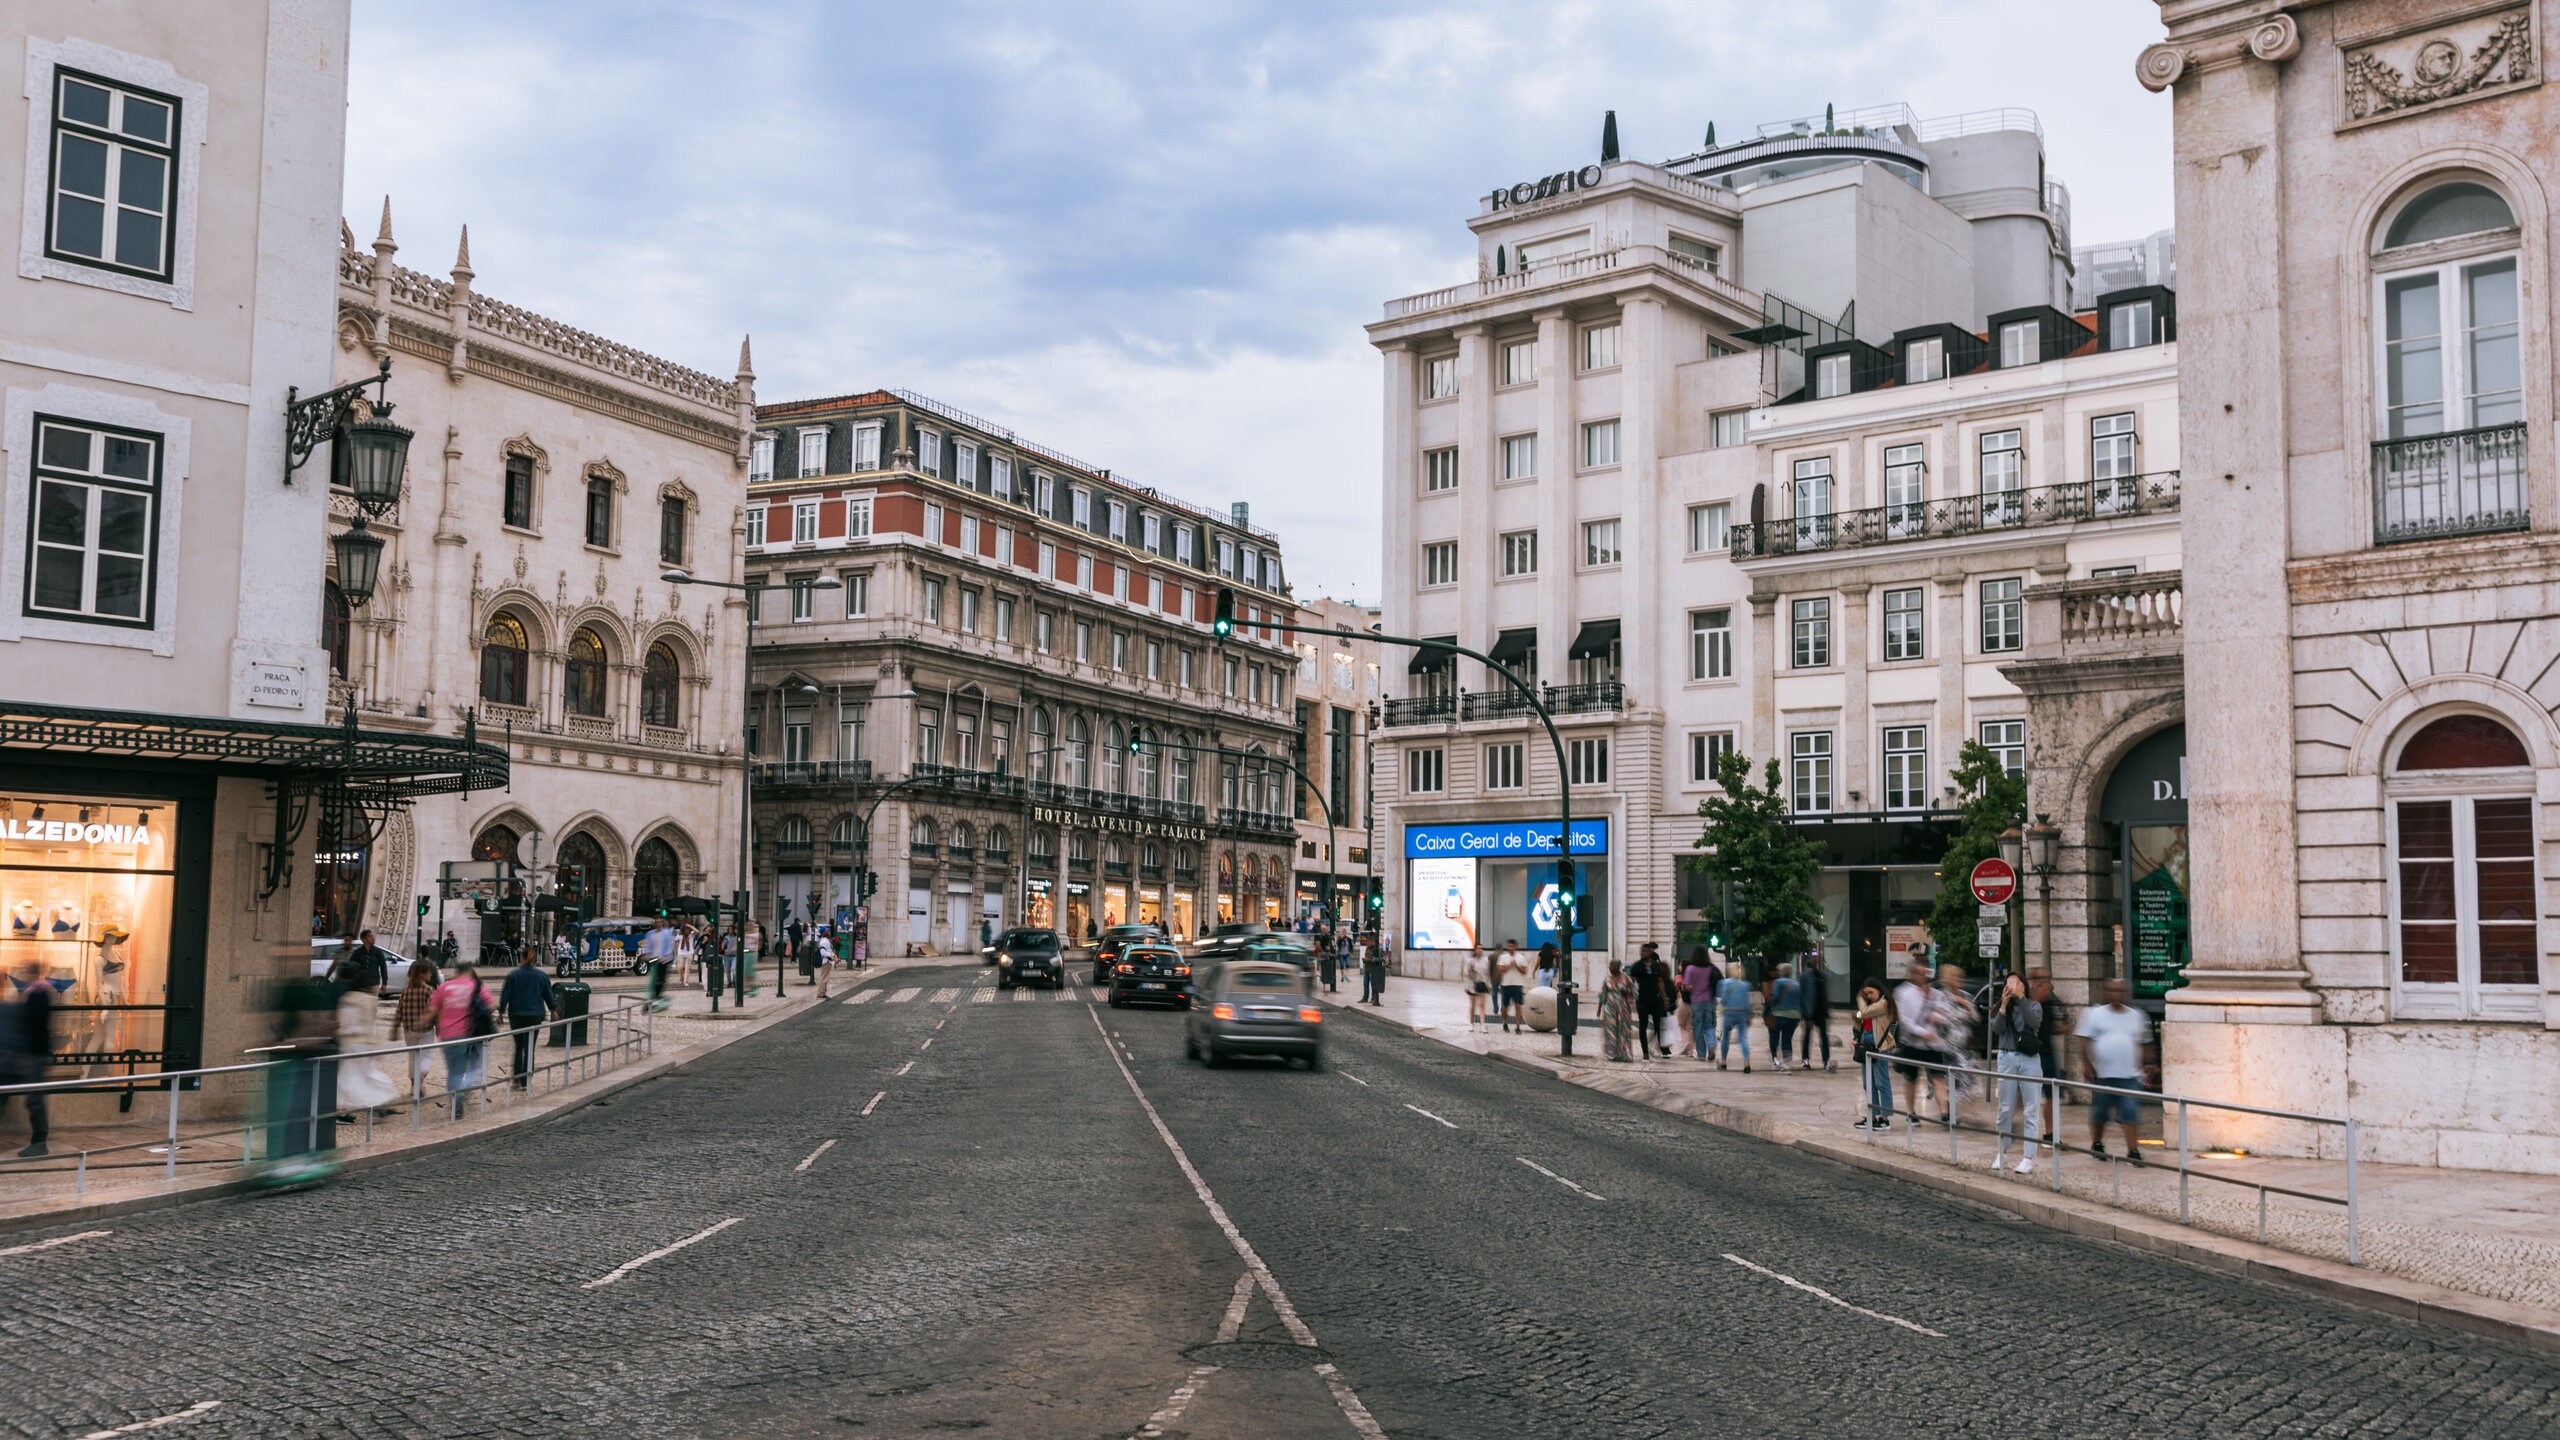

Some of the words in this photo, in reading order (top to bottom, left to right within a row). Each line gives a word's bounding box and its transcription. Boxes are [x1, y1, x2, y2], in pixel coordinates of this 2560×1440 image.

[1492, 165, 1602, 211] ROSSIO
[263, 686, 289, 695] PEDRO
[1034, 807, 1080, 825] HOTEL
[1091, 815, 1152, 835] AVENIDA
[1161, 824, 1206, 841] PALACE
[1415, 833, 1455, 850] Caixa
[1460, 832, 1499, 849] Geral
[1503, 832, 1522, 848] de
[1527, 830, 1596, 851] Depitos
